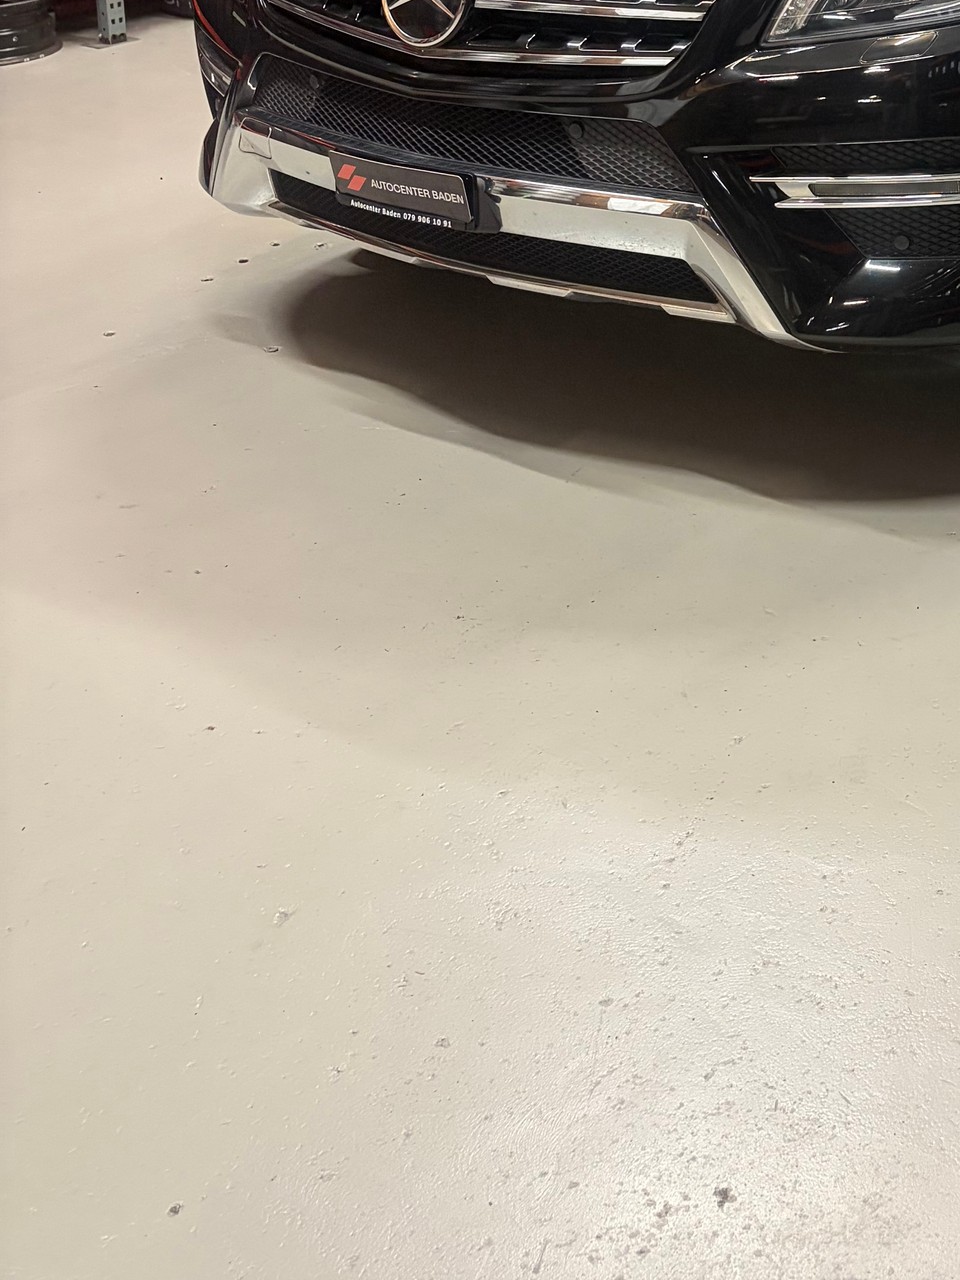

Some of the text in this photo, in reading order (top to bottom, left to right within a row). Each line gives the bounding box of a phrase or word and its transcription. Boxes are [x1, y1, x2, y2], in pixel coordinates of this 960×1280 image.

[371, 179, 465, 205] AUTOCENTER BADEN
[350, 199, 381, 214] Autocenter
[382, 208, 401, 219] Baden
[403, 212, 416, 222] 079
[432, 218, 442, 226] 10
[443, 220, 452, 228] 91
